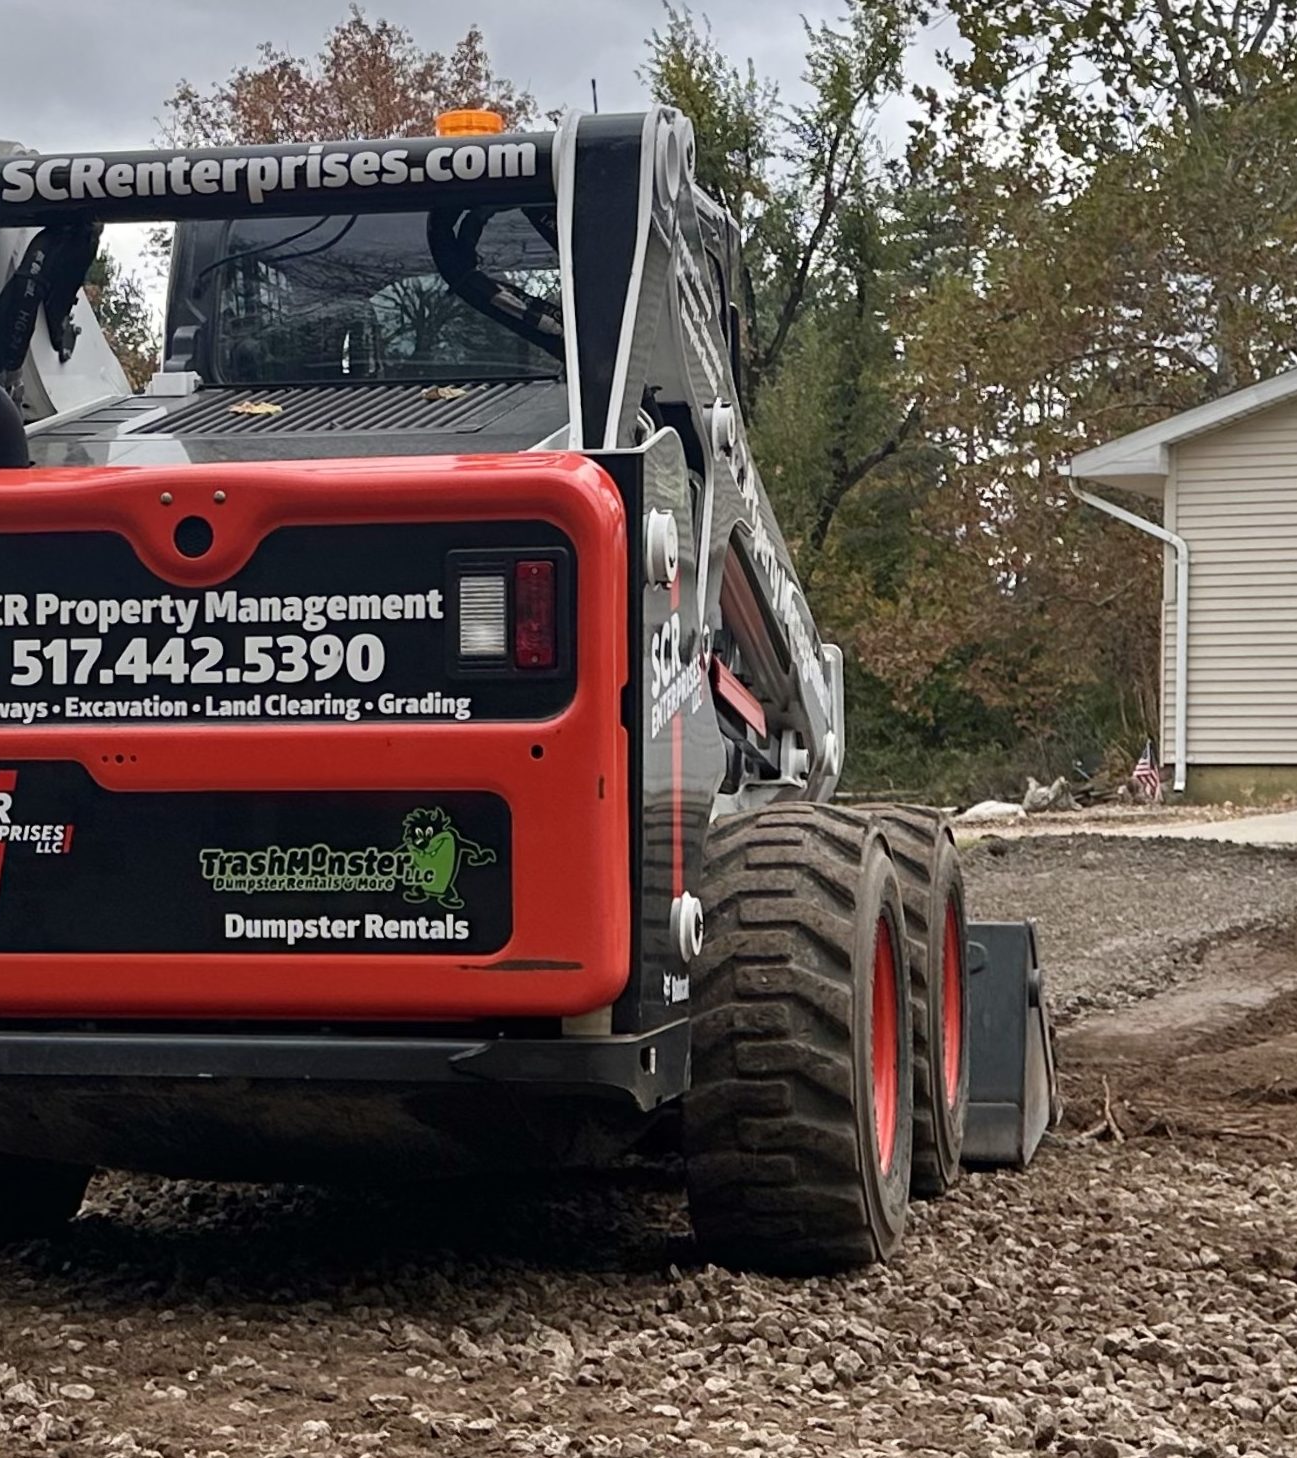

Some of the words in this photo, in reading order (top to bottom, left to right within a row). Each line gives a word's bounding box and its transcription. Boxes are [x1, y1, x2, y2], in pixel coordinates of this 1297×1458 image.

[2, 144, 536, 203] SCRenterprises.com
[35, 593, 199, 633] Property
[205, 589, 444, 631] Management
[10, 633, 385, 686] 517.442.5390
[651, 612, 682, 699] SCR
[65, 695, 188, 718] Excavation
[205, 695, 261, 716] Land
[265, 693, 361, 721] Clearing
[378, 692, 471, 720] Grading
[35, 842, 63, 853] LLC
[214, 877, 285, 893] Dumpster
[286, 876, 341, 890] Rentals
[356, 877, 395, 890] More
[403, 868, 435, 884] LLC
[225, 913, 359, 945] Dumpster
[364, 914, 469, 940] Rentals
